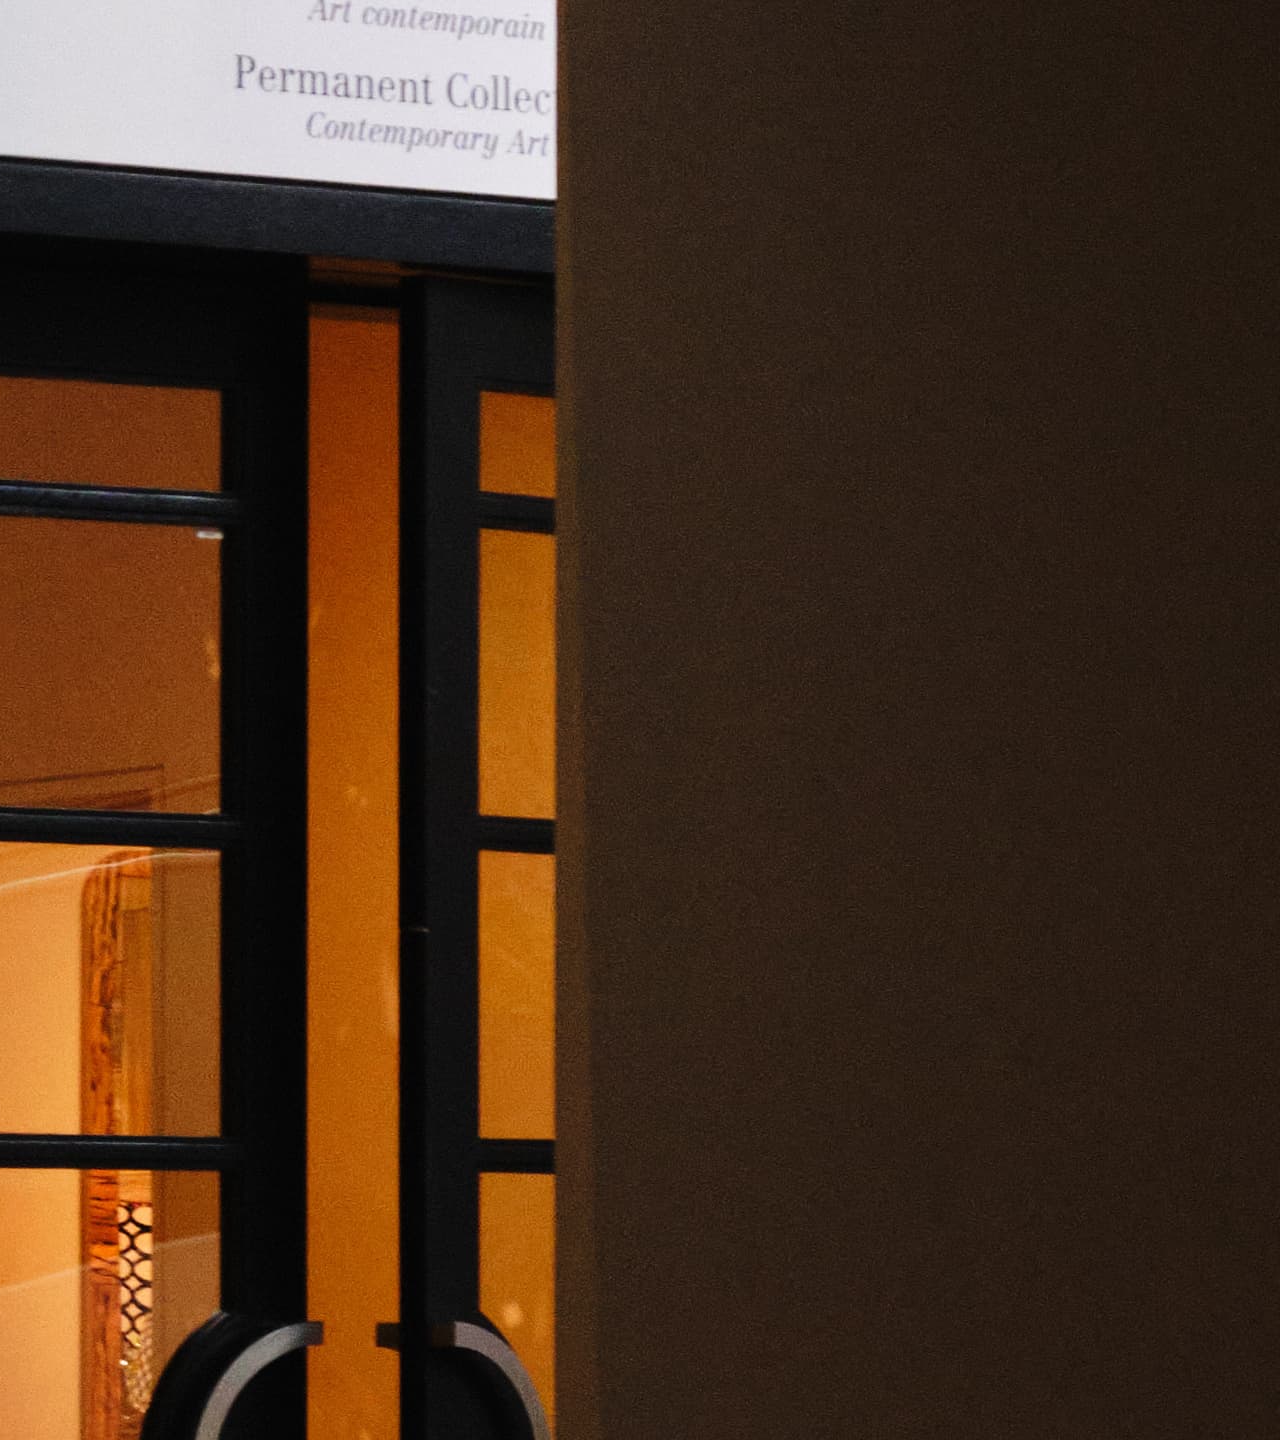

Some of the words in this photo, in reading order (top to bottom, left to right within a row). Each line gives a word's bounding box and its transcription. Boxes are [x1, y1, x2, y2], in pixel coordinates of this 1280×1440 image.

[361, 3, 546, 41] contemporain
[233, 53, 433, 106] Permanent
[446, 72, 556, 116] Collec
[305, 111, 500, 160] Contemporary
[505, 129, 551, 158] Art
